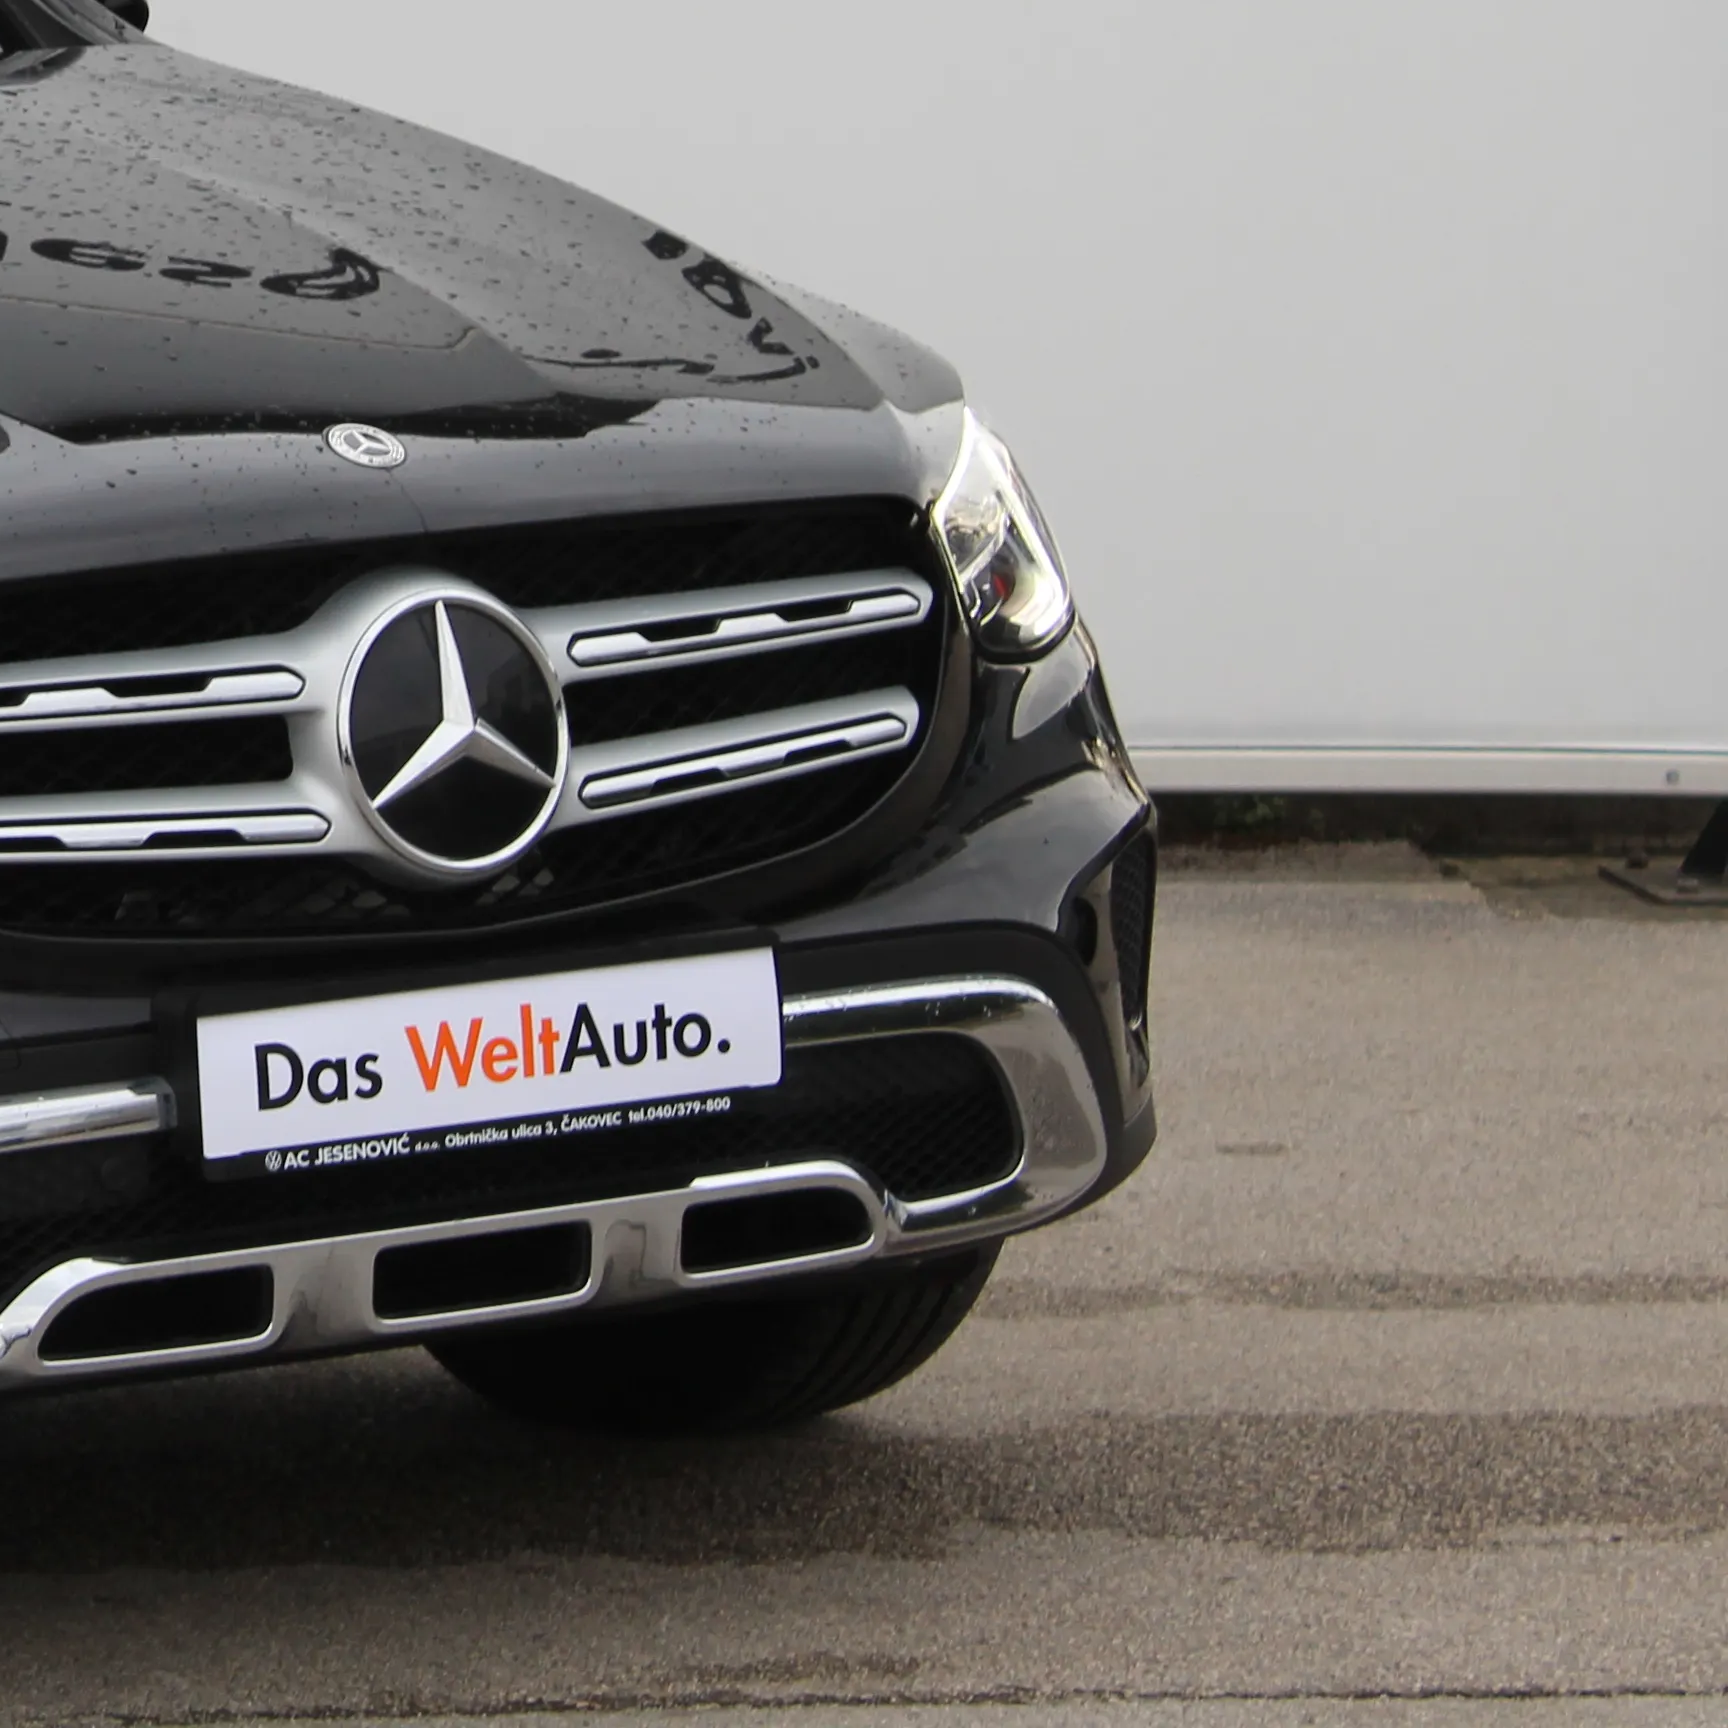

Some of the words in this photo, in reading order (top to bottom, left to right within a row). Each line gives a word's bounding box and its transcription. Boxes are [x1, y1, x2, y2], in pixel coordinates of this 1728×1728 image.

[253, 1041, 384, 1113] Das
[404, 1001, 732, 1093] WeltAuto.
[283, 1148, 311, 1170] AC
[313, 1132, 412, 1166] JESENOVIĆ
[444, 1125, 509, 1148] Obrtnička
[511, 1122, 543, 1140] ulica
[544, 1120, 559, 1136] 3,
[560, 1110, 623, 1133] ČAKOVEC
